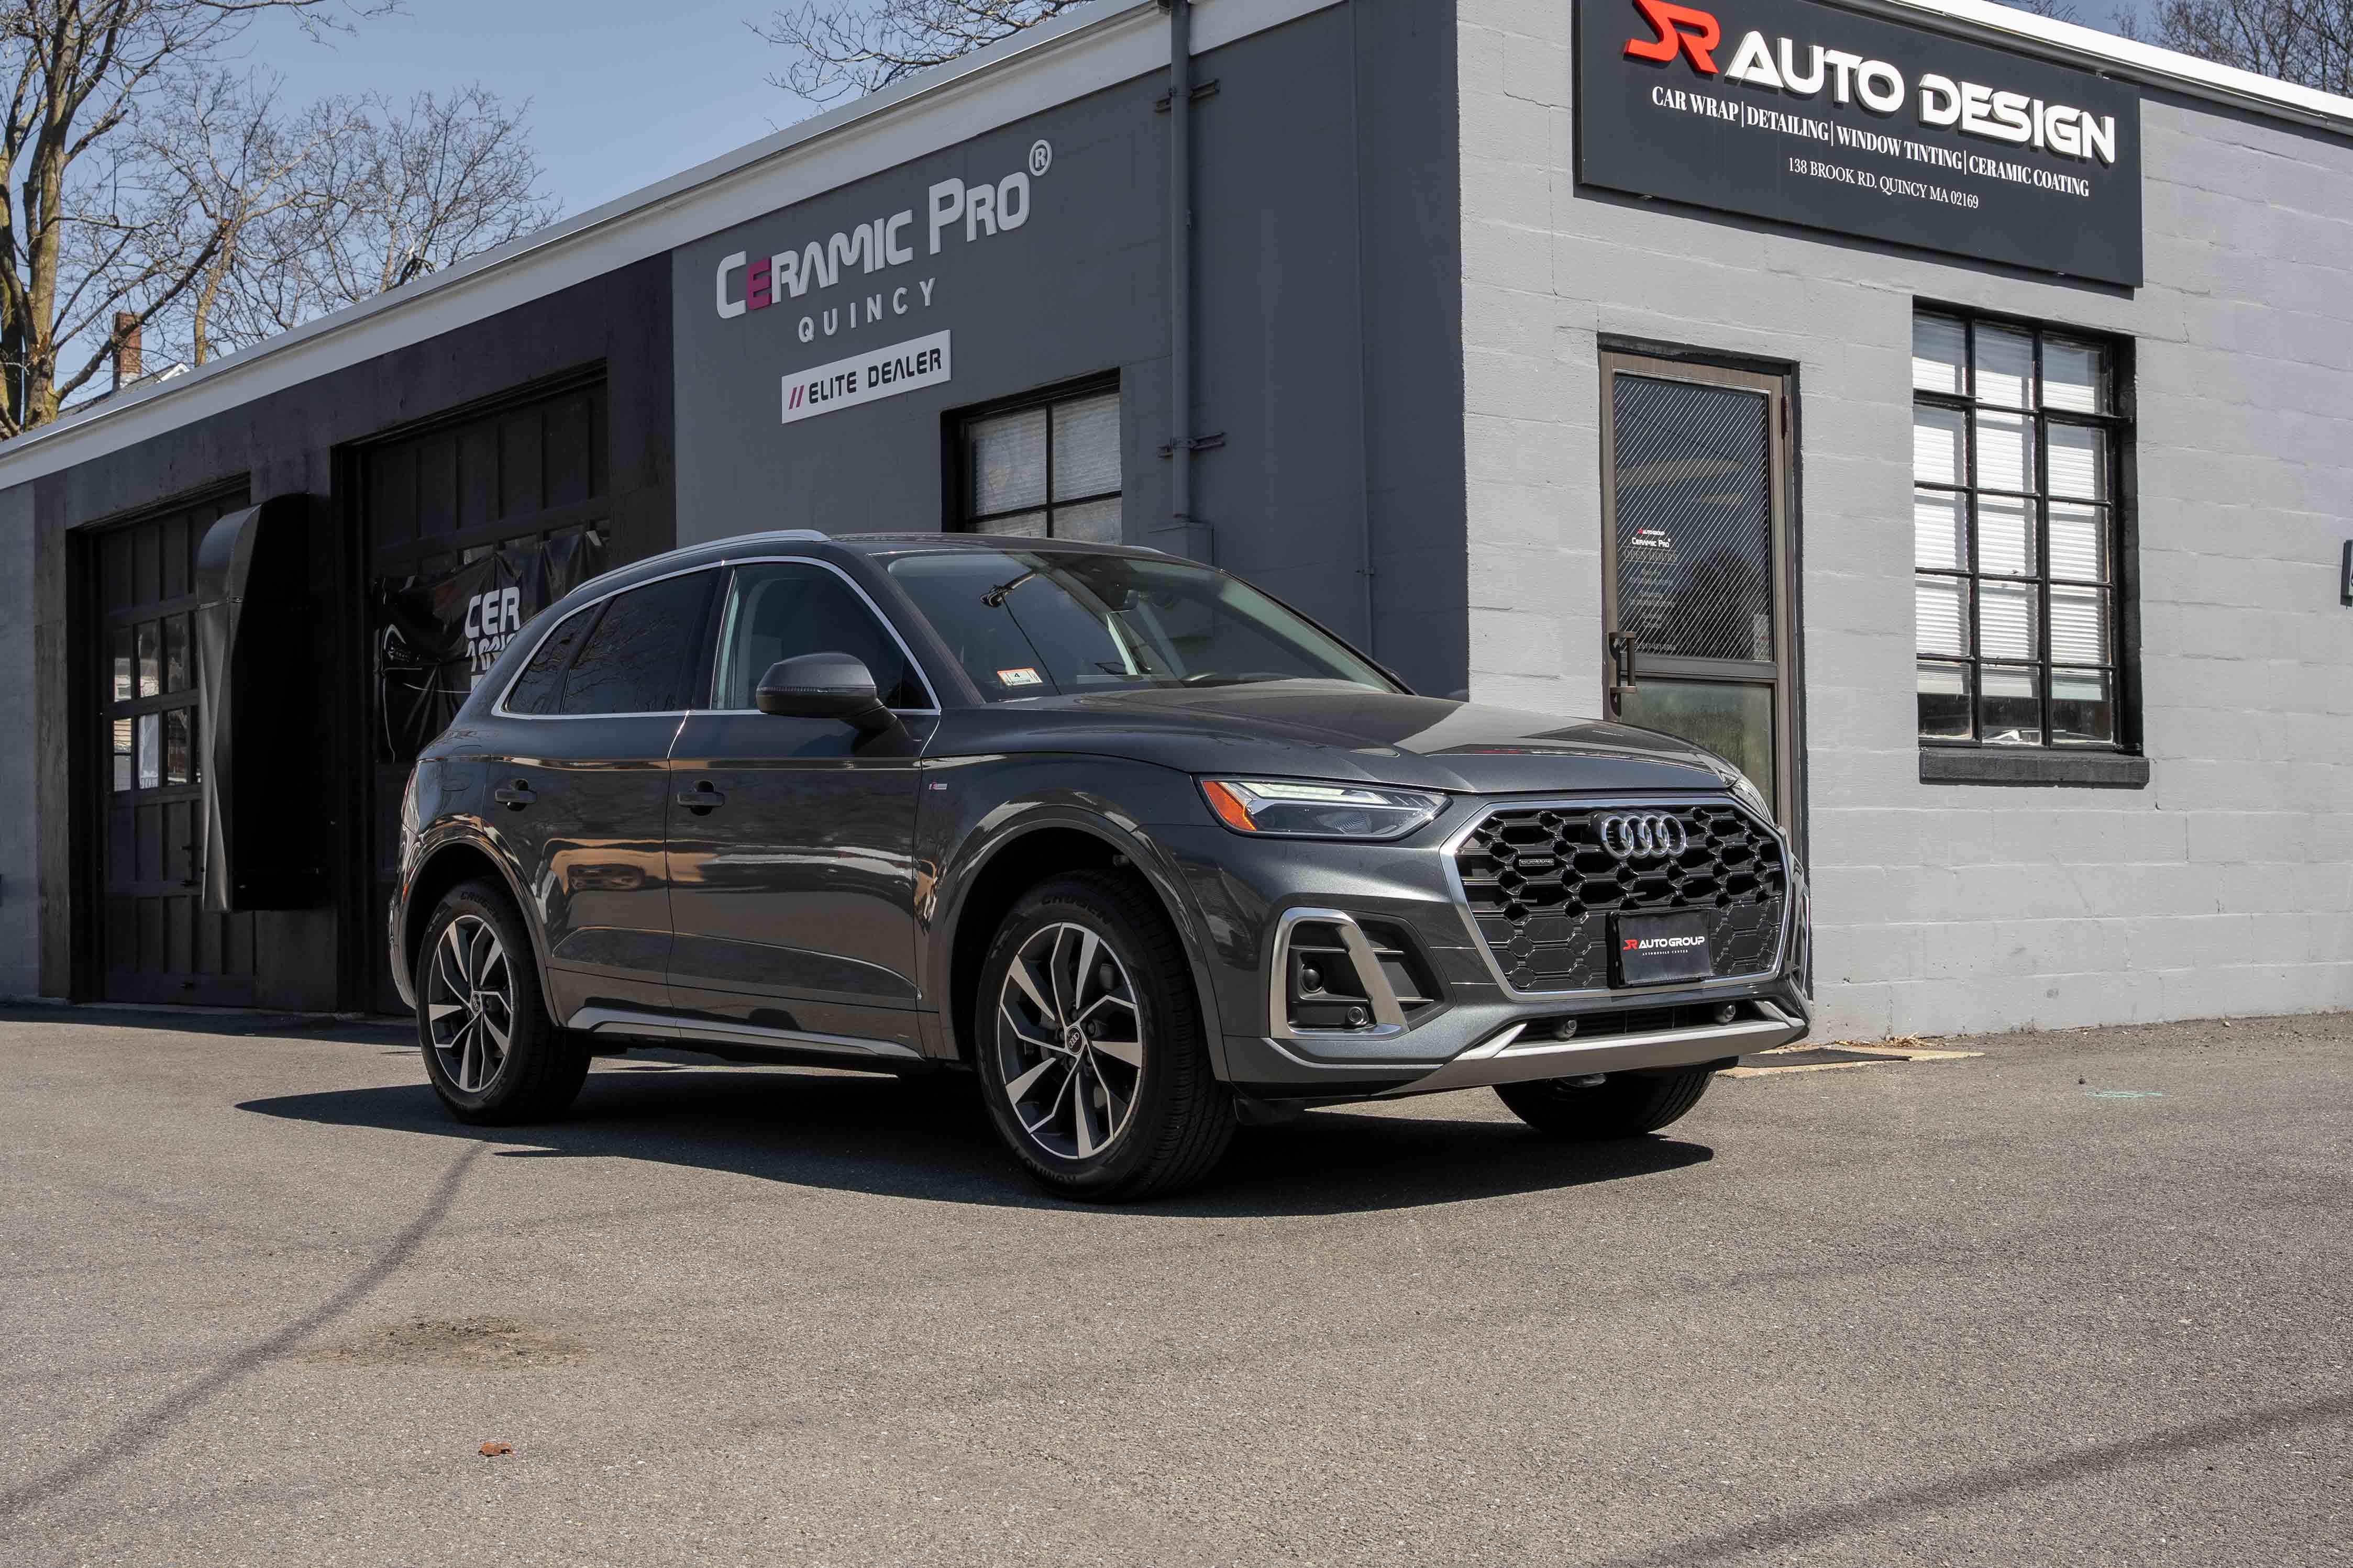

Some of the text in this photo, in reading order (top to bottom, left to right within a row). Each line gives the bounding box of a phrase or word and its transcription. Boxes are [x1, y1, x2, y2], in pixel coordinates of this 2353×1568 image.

[1724, 30, 1905, 113] AUTO
[1919, 73, 2115, 163] DESIGN
[1652, 86, 1687, 111] CAR
[1836, 125, 1902, 157] WINDOW
[1969, 155, 2031, 184] CERAMIC
[2033, 169, 2090, 197] COATING
[1789, 157, 1979, 209] 138 BROOK RD. QUINCY MA 02169
[716, 209, 913, 319] CERAMIC
[798, 277, 936, 343] QUINCY
[867, 348, 942, 389] DEALER
[1632, 537, 1656, 547] CERAMIC
